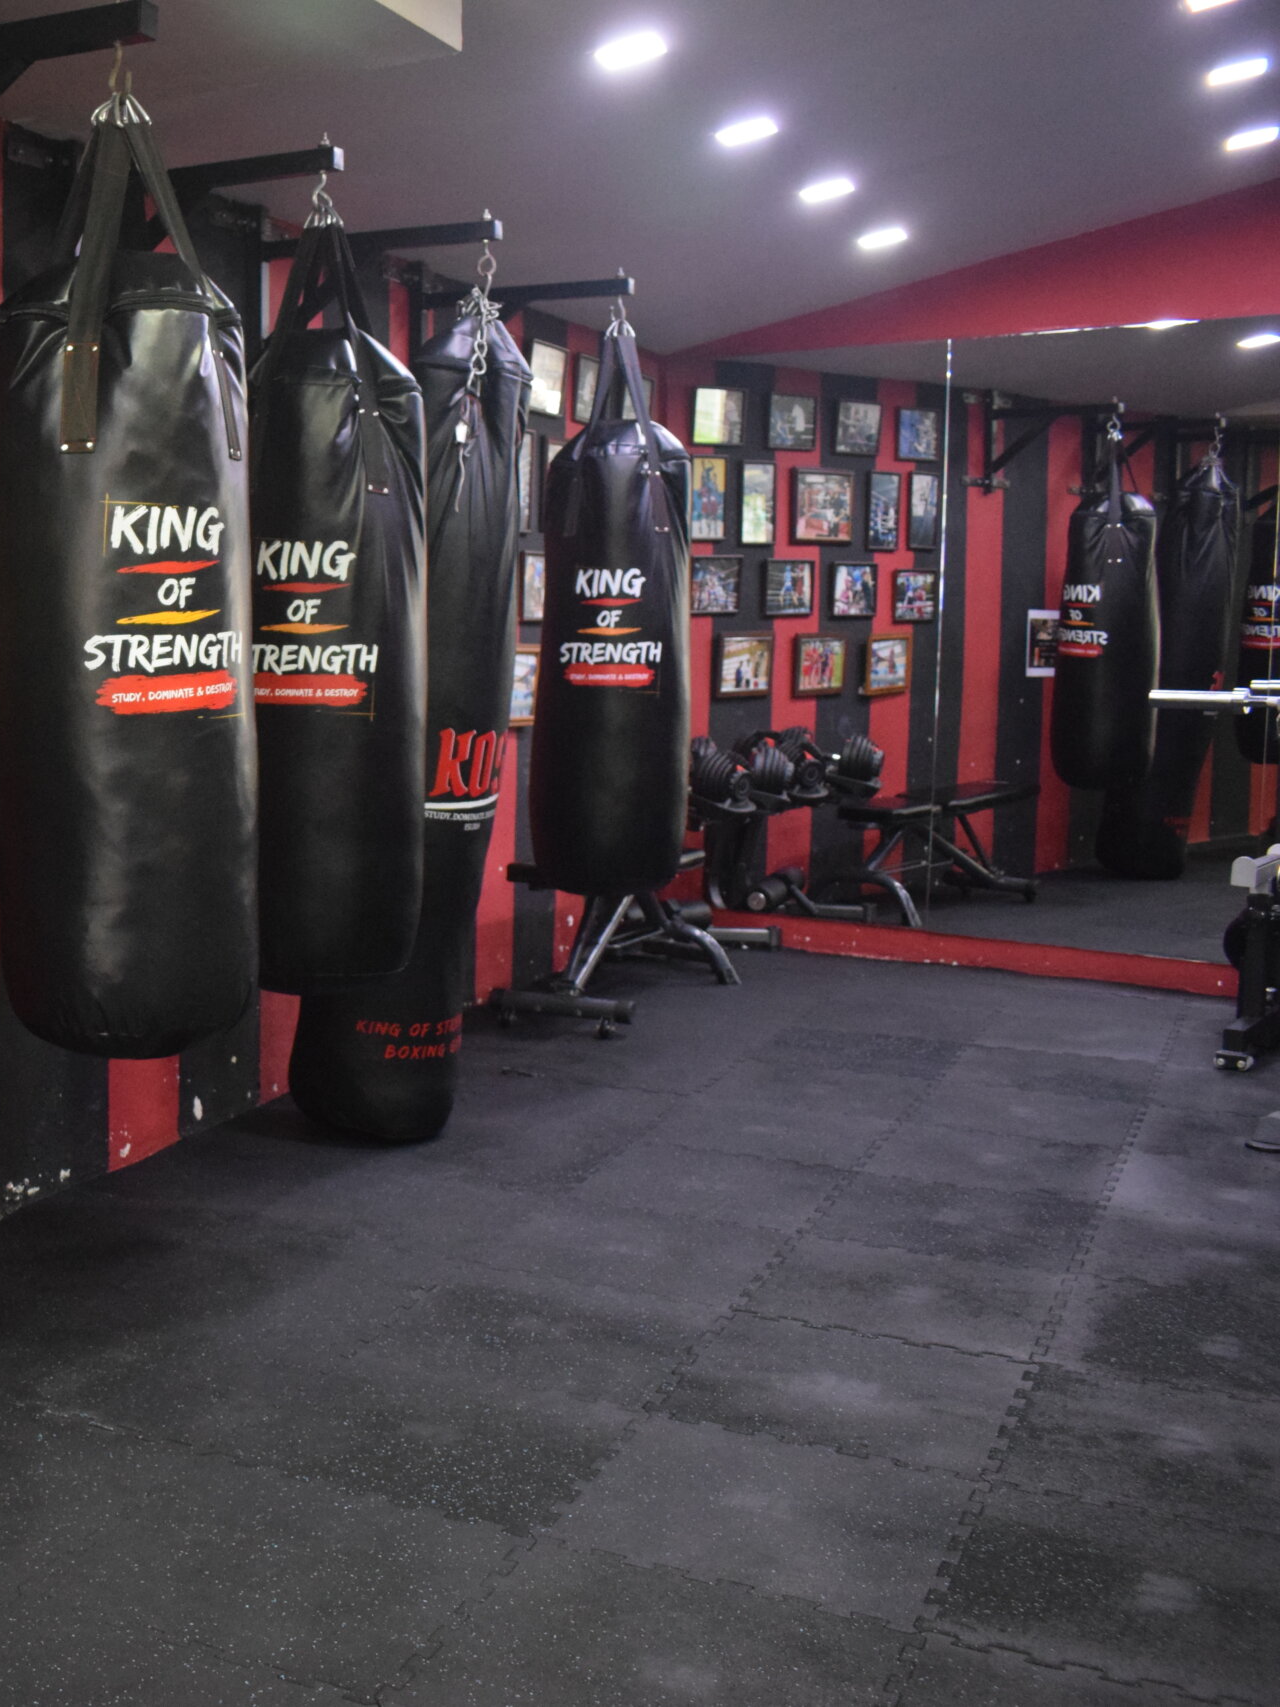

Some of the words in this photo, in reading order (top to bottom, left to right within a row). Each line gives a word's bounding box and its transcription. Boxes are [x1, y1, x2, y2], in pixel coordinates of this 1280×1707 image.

[110, 505, 224, 555] KING
[256, 540, 356, 581] KING
[157, 577, 196, 609] OF
[575, 568, 647, 598] KING
[287, 599, 321, 624] OF
[596, 610, 622, 628] OF
[83, 631, 243, 673] STRENGTH
[251, 643, 379, 676] TRENGTH
[559, 641, 663, 666] STRENGTH
[148, 687, 194, 701] DOMINATE
[196, 686, 205, 696] &
[205, 682, 233, 695] DESTROY
[274, 688, 314, 697] DOMINATE
[324, 688, 359, 698] DESTROY
[355, 1019, 402, 1037] KING
[408, 1022, 430, 1037] OF
[384, 1043, 445, 1059] BOXING
